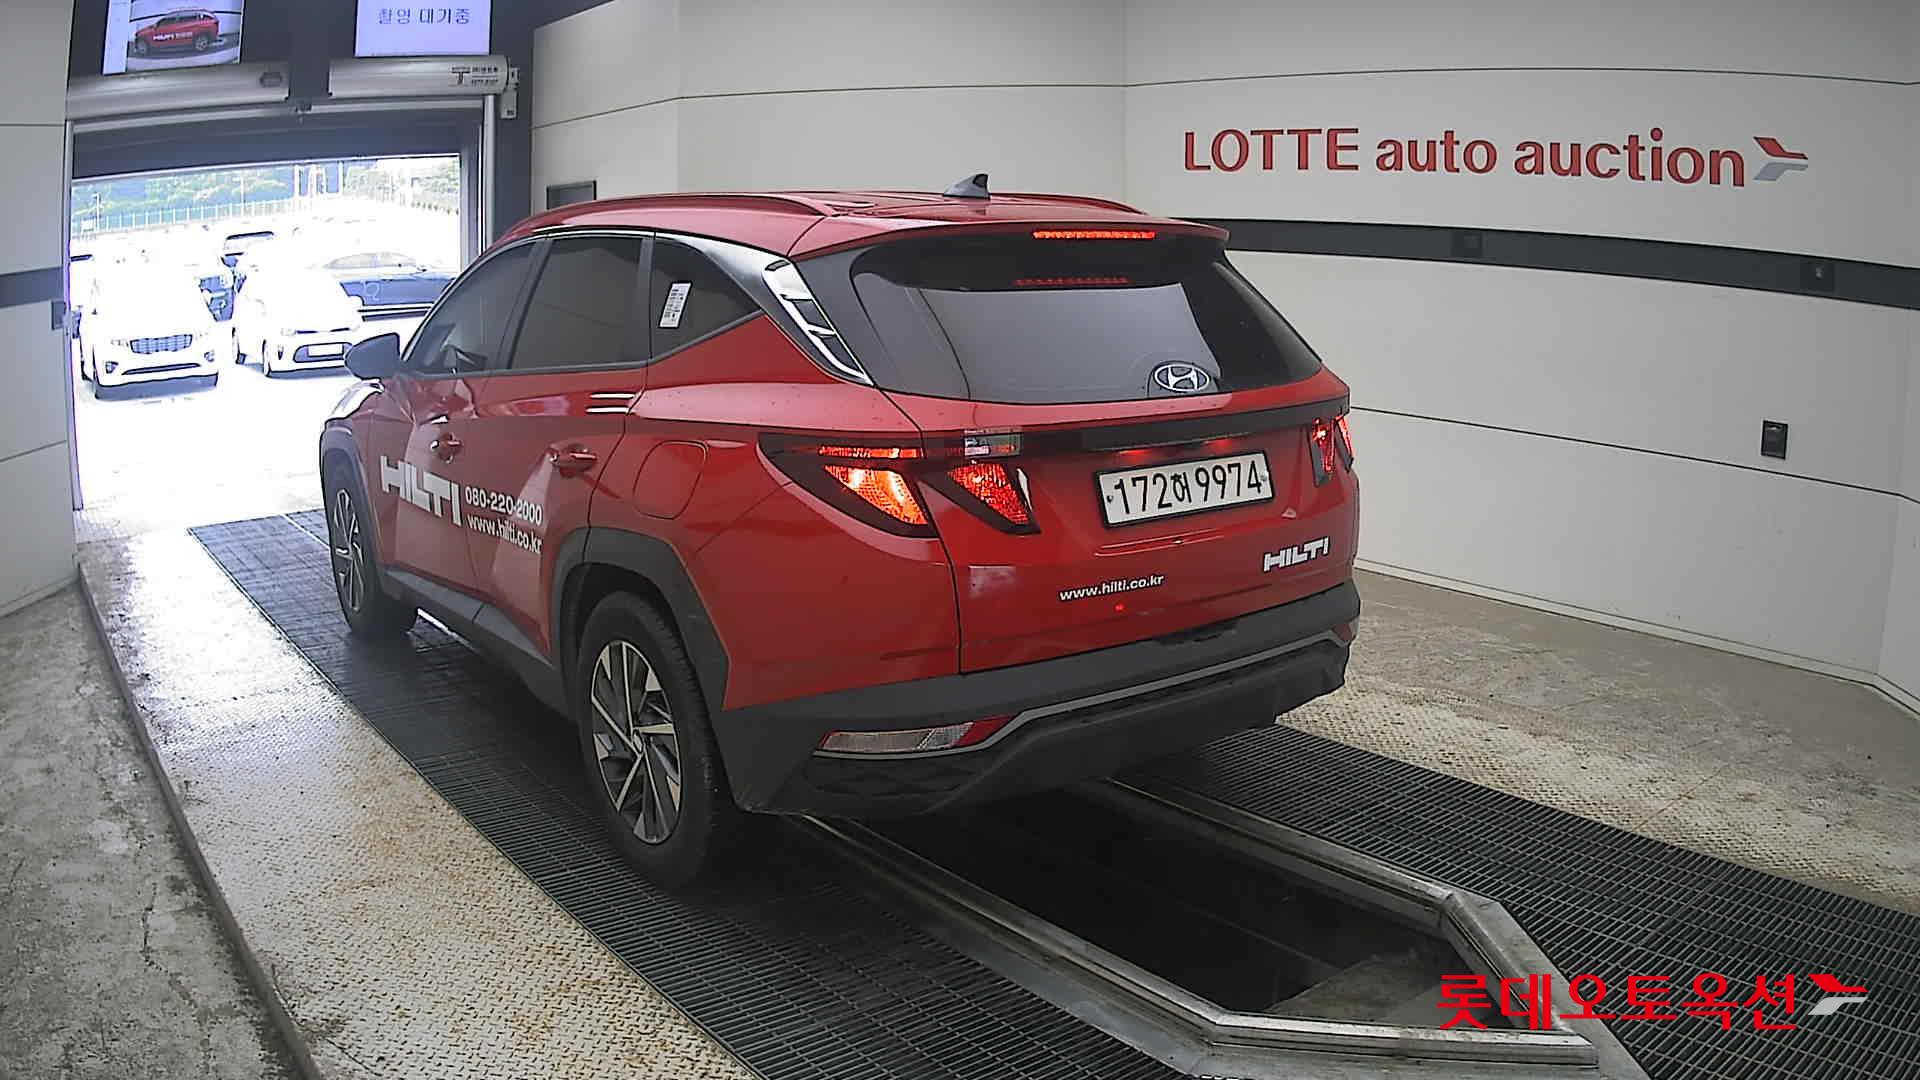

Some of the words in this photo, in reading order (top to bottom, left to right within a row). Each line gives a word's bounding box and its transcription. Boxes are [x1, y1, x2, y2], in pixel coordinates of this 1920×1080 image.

[419, 8, 470, 24] 대기중
[1184, 128, 1359, 171] LOTTE
[1376, 130, 1497, 174] auto
[1514, 128, 1745, 187] auction
[380, 455, 464, 527] HILTI
[465, 486, 543, 526] 080-220-2000
[466, 514, 543, 554] www.hilti.co.kr
[1263, 537, 1329, 572] HILTI
[1060, 574, 1165, 601] www.hilti.co.kr
